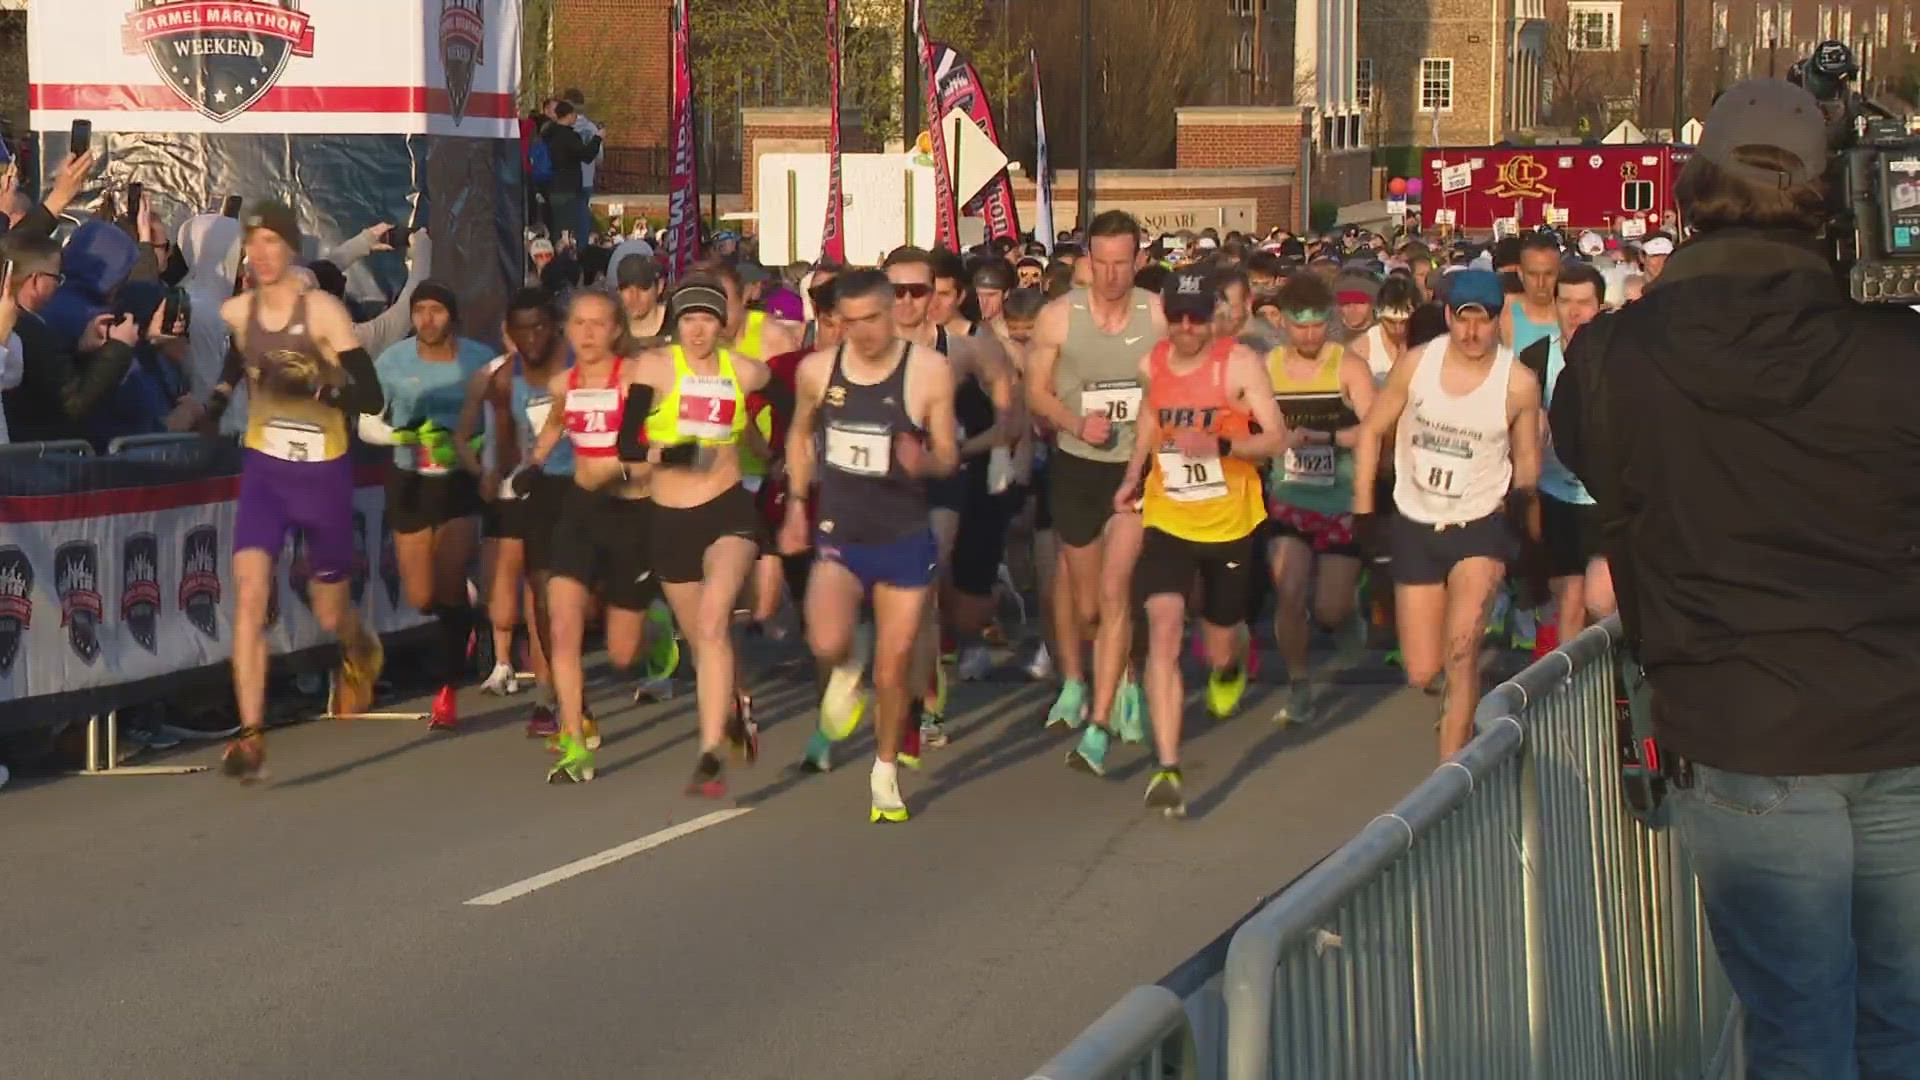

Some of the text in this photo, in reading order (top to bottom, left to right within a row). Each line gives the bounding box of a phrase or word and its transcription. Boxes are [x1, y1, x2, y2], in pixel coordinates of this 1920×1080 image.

[135, 8, 302, 33] CARMEL MARATHON
[173, 38, 265, 57] WEEKEND
[708, 396, 721, 423] 2
[1105, 400, 1128, 420] 76
[1182, 463, 1207, 484] 70
[1428, 466, 1454, 491] 81
